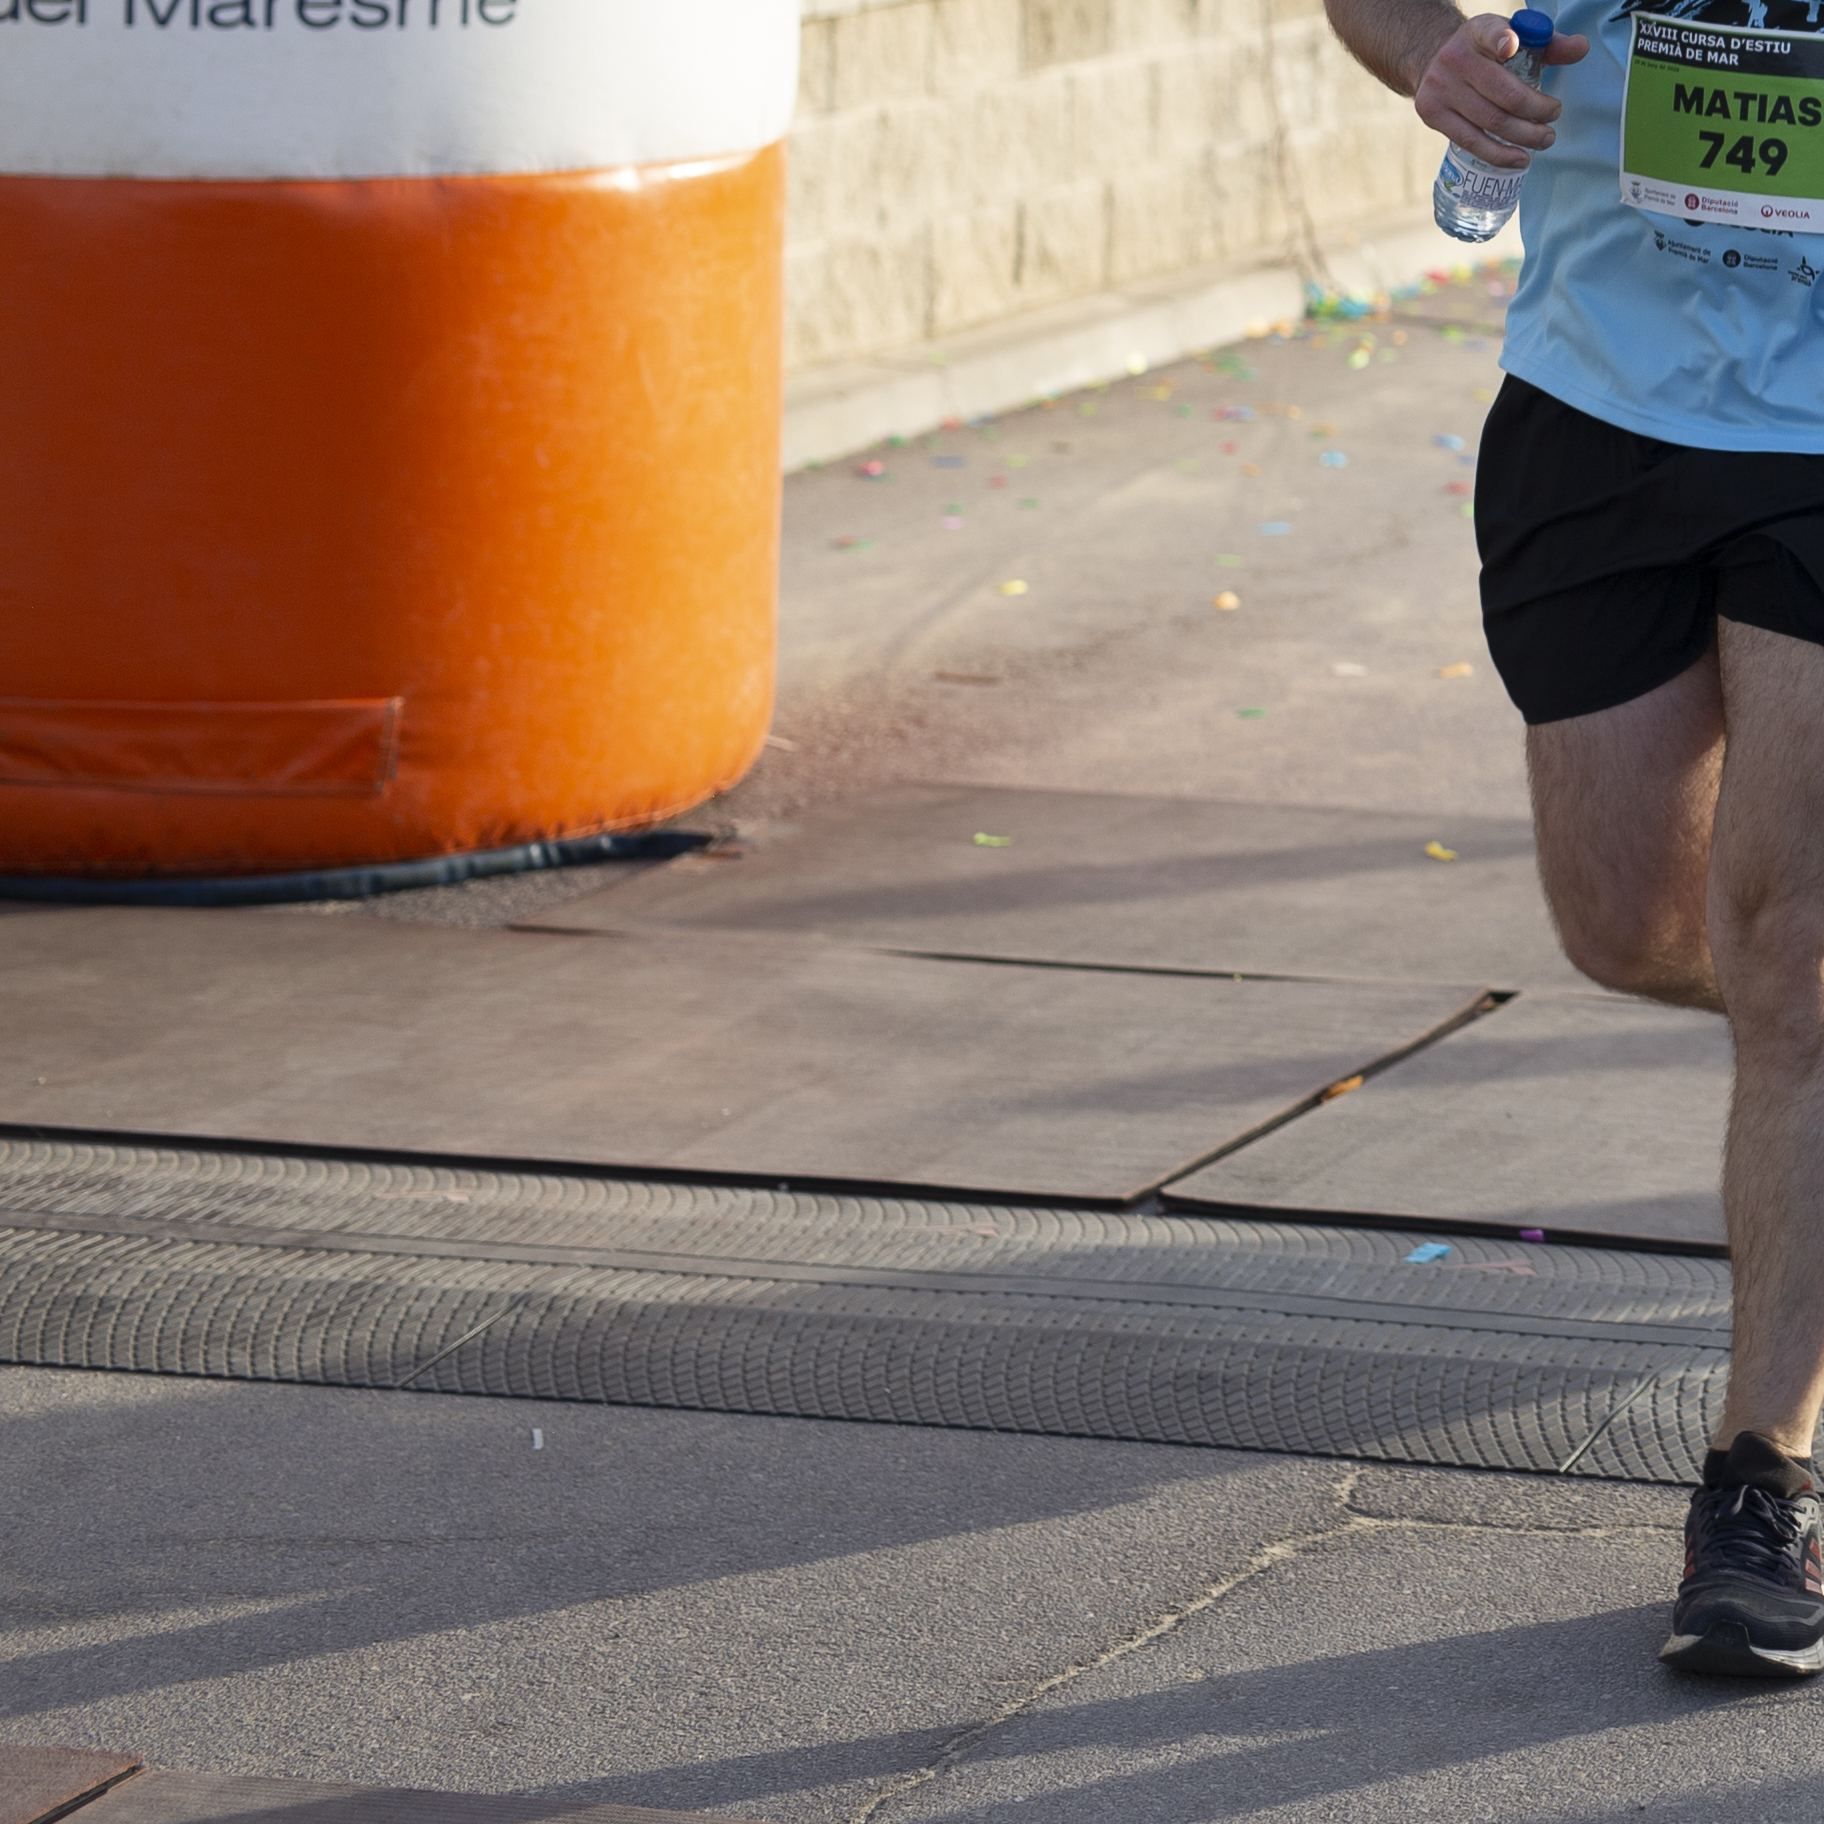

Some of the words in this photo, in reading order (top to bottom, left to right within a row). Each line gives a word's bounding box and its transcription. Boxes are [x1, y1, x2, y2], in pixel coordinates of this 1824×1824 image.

[1637, 37, 1683, 58] PREMIÀ
[1685, 47, 1703, 61] DE
[1707, 50, 1739, 67] MAR
[1639, 21, 1678, 41] XXVIII
[1681, 30, 1726, 49] CURSA
[1730, 37, 1791, 55] D'ESTIU
[1673, 82, 1822, 127] MATIAS
[1698, 130, 1788, 176] 749
[1701, 204, 1738, 215] Barcelona
[1775, 208, 1810, 219] VEOLIA
